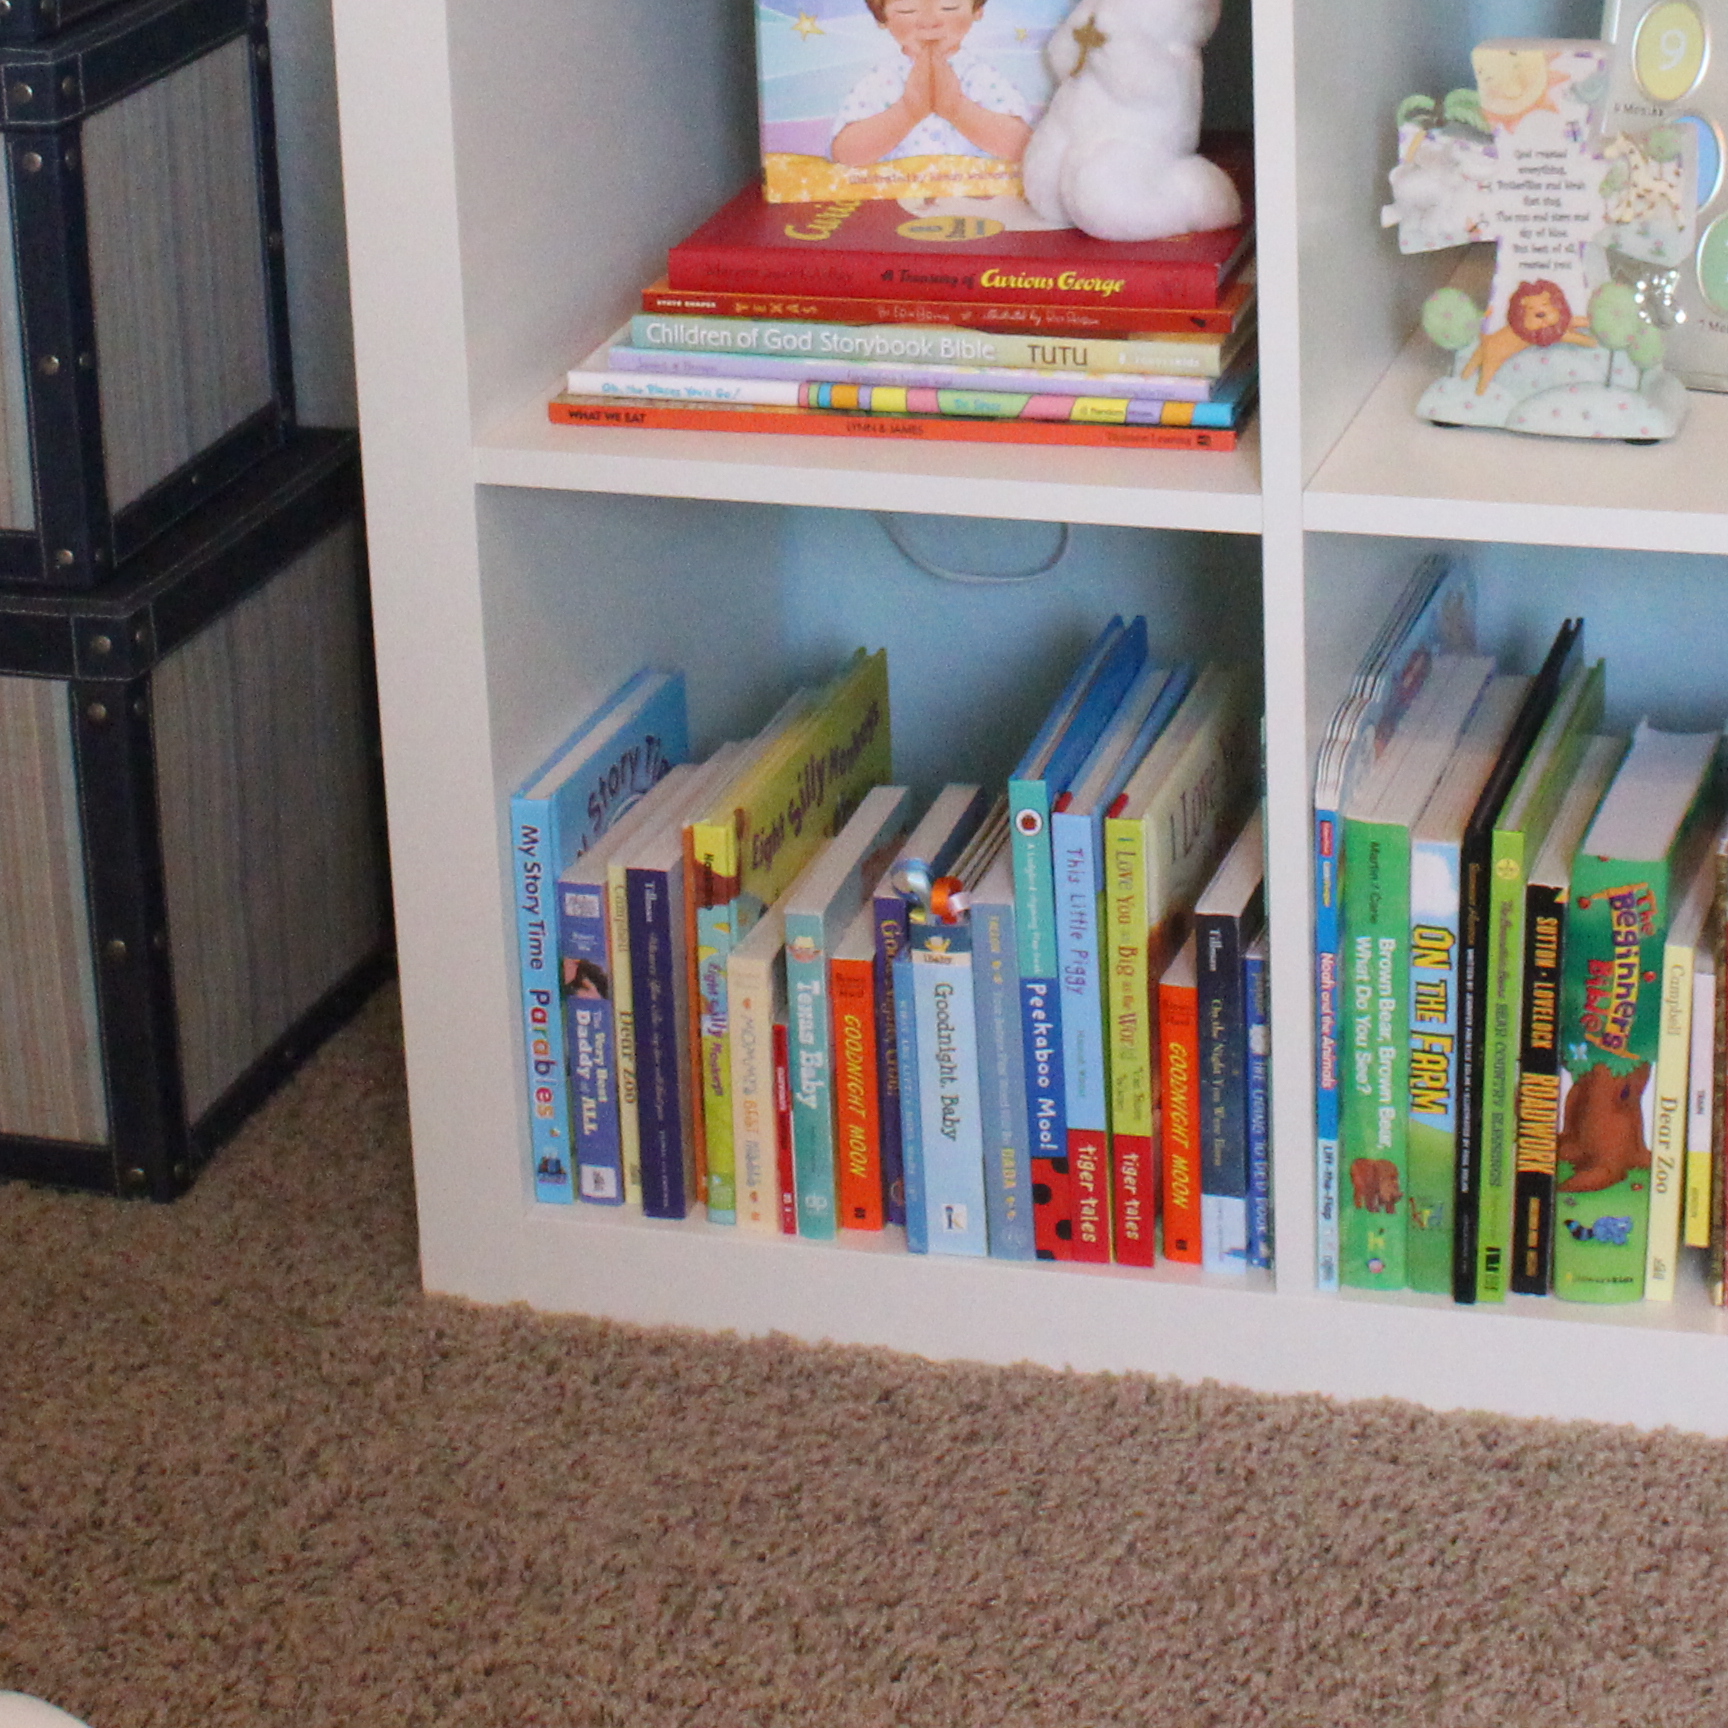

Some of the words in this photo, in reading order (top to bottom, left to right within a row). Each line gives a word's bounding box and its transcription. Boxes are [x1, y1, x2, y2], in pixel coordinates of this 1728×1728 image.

[1658, 28, 1688, 71] 9
[979, 267, 1055, 291] Curious
[1057, 270, 1126, 297] George
[646, 323, 732, 347] Children
[736, 325, 759, 348] of
[763, 328, 813, 351] God
[821, 332, 932, 359] Storybook
[939, 336, 996, 361] Bible
[1027, 344, 1088, 367] TUTU
[624, 412, 646, 424] EAT
[518, 825, 541, 858] My
[1066, 847, 1085, 884] This
[1116, 850, 1138, 891] Love
[523, 862, 545, 917] Story
[1116, 894, 1135, 925] You
[1068, 892, 1087, 940] Little
[1637, 890, 1659, 936] The
[528, 919, 547, 970] Time
[1116, 946, 1139, 977] Big
[1209, 928, 1223, 972] Tillman
[1354, 935, 1372, 975] What
[1413, 925, 1456, 969] ON
[1535, 916, 1559, 969] SUTTON
[704, 963, 723, 996] Eight
[1064, 948, 1088, 996] Piggy
[1320, 952, 1338, 988] Noah
[1376, 937, 1397, 995] Brown
[796, 980, 823, 1046] Texas
[1210, 998, 1223, 1019] On
[1321, 990, 1335, 1014] and
[1354, 985, 1372, 1009] Do
[1415, 982, 1448, 1025] THE
[1531, 981, 1554, 1049] LOVELOCK
[1581, 959, 1614, 1035] Bible
[1665, 963, 1686, 1037] Campbell
[619, 1010, 636, 1060] Dear
[1025, 982, 1052, 1089] Peekaboo
[1118, 1013, 1139, 1060] World
[1211, 1020, 1226, 1040] the
[1321, 1014, 1335, 1035] the
[1354, 1013, 1372, 1047] You
[1374, 998, 1397, 1042] Bear,
[529, 988, 558, 1120] Parables
[576, 1009, 593, 1080] Daddy
[593, 1032, 606, 1067] Very
[842, 1014, 868, 1119] GOODNIGHT
[1209, 1042, 1228, 1075] Night
[1320, 1036, 1337, 1090] Animals
[596, 1068, 608, 1103] Best
[623, 1068, 637, 1104] Zoo
[708, 1042, 725, 1097] Monkeys
[795, 1050, 825, 1110] Baby
[1211, 1078, 1227, 1103] You
[1354, 1050, 1373, 1094] See?
[1376, 1046, 1397, 1104] Brown
[1412, 1030, 1454, 1116] FARM
[582, 1096, 598, 1136] ALL
[1169, 1041, 1190, 1149] GOODNIGHT
[1695, 1089, 1706, 1116] TRAIN
[939, 1094, 960, 1142] Baby
[1037, 1098, 1059, 1151] Moo!
[1212, 1106, 1227, 1135] Were
[1374, 1107, 1395, 1150] Bear,
[1516, 1074, 1559, 1173] ROADWORK
[1658, 1095, 1679, 1150] Dear
[848, 1124, 869, 1179] MOON
[1076, 1144, 1099, 1192] tiger
[1122, 1152, 1141, 1194] tiger
[1170, 1153, 1190, 1210] MOON
[1654, 1155, 1676, 1195] Zoo
[1080, 1197, 1101, 1243] tales
[1123, 1198, 1142, 1240] tales
